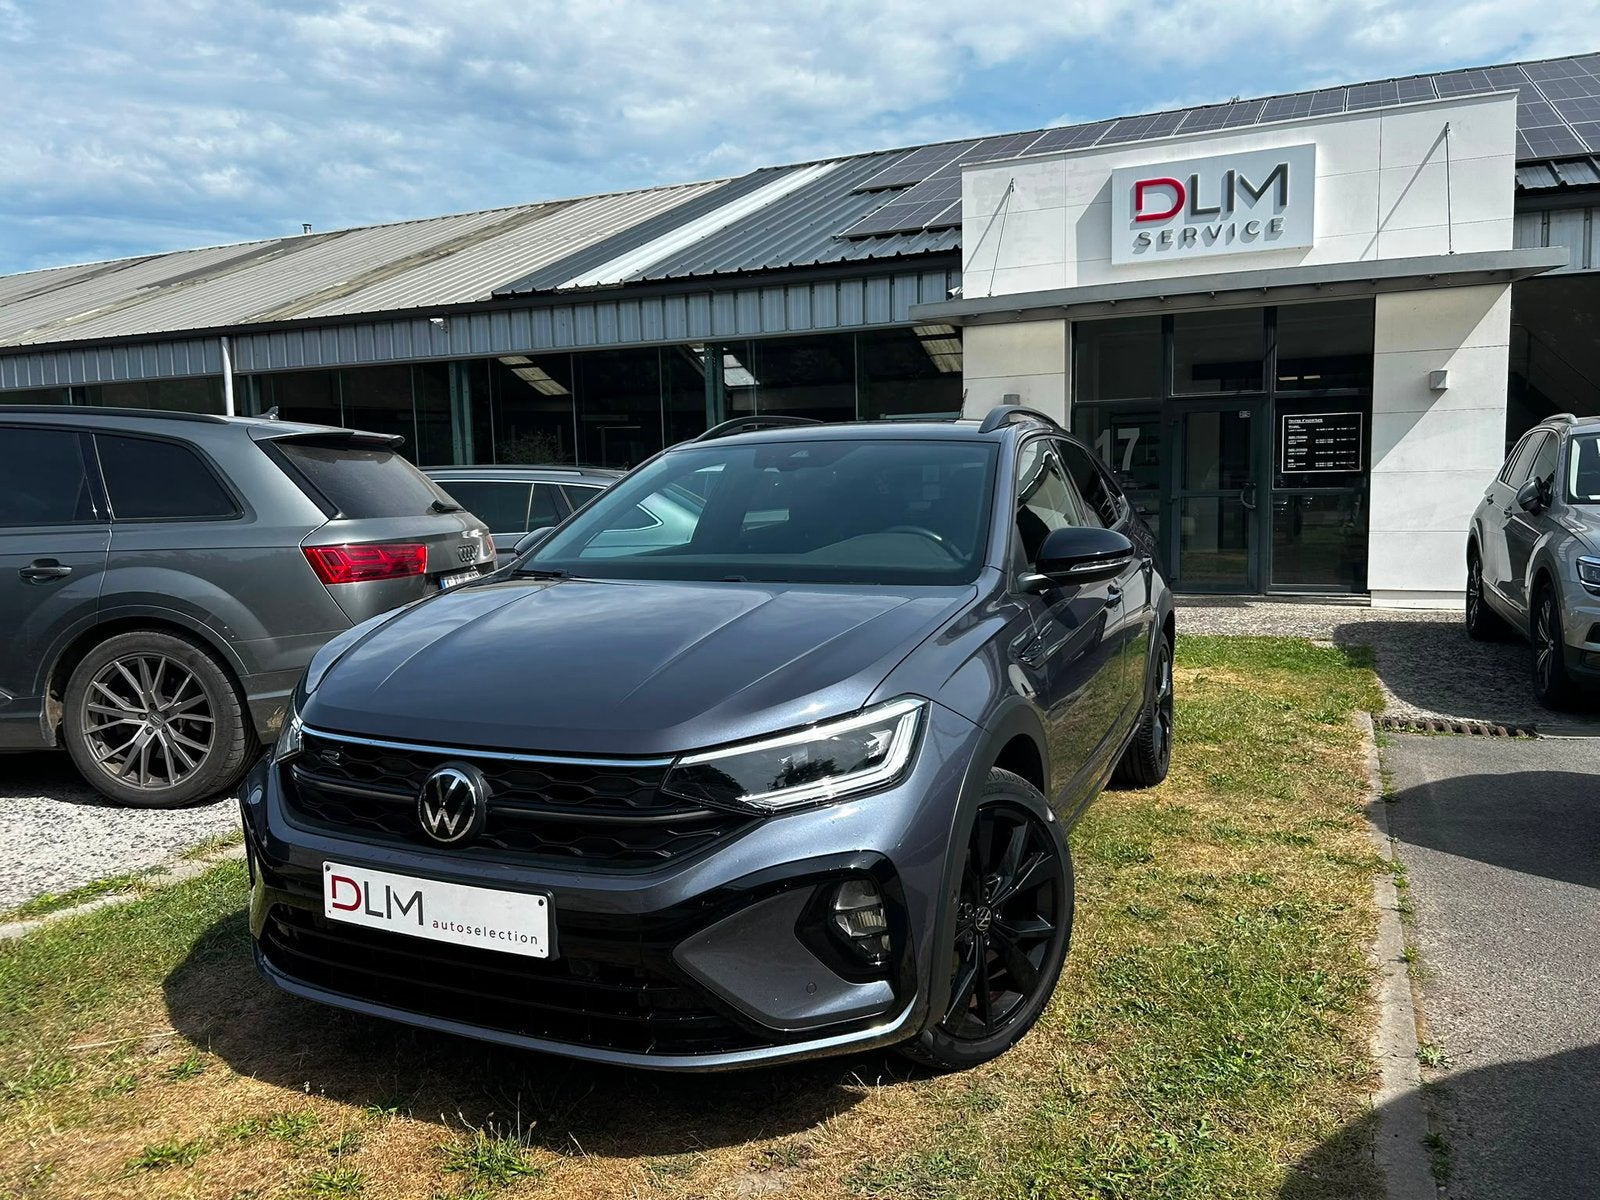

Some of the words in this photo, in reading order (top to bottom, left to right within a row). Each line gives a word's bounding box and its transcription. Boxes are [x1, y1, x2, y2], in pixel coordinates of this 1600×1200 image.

[1135, 162, 1289, 223] DLM
[1137, 217, 1285, 247] SERVICE
[1094, 427, 1140, 471] 17
[331, 874, 424, 926] DLM
[432, 918, 538, 945] autoselection
